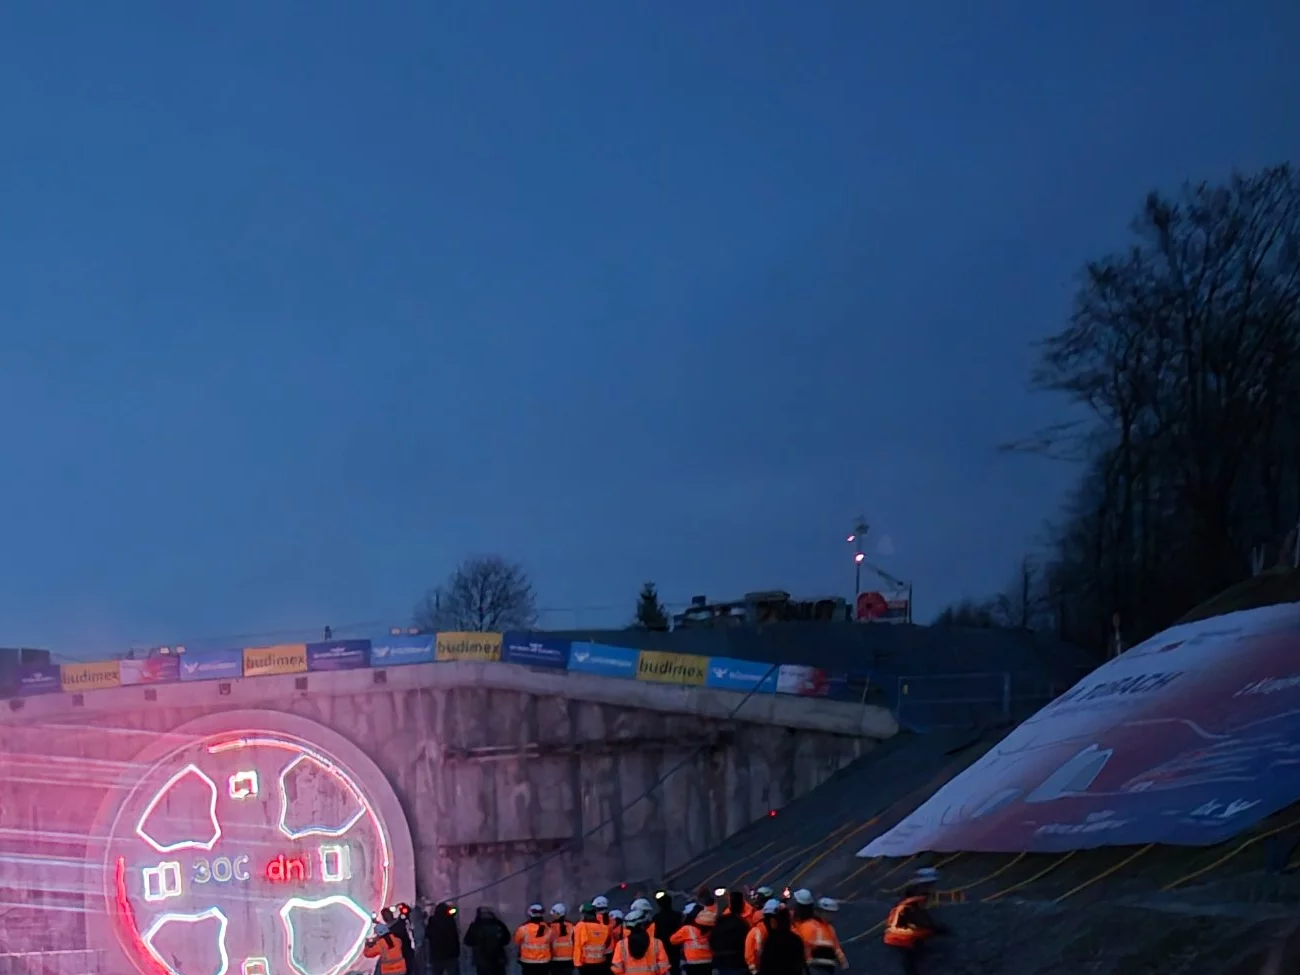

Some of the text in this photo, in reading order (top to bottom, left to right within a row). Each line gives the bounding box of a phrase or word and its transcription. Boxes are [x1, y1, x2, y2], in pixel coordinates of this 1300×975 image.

[437, 640, 500, 654] budimex
[246, 654, 305, 669] budimex
[639, 657, 704, 678] budimex
